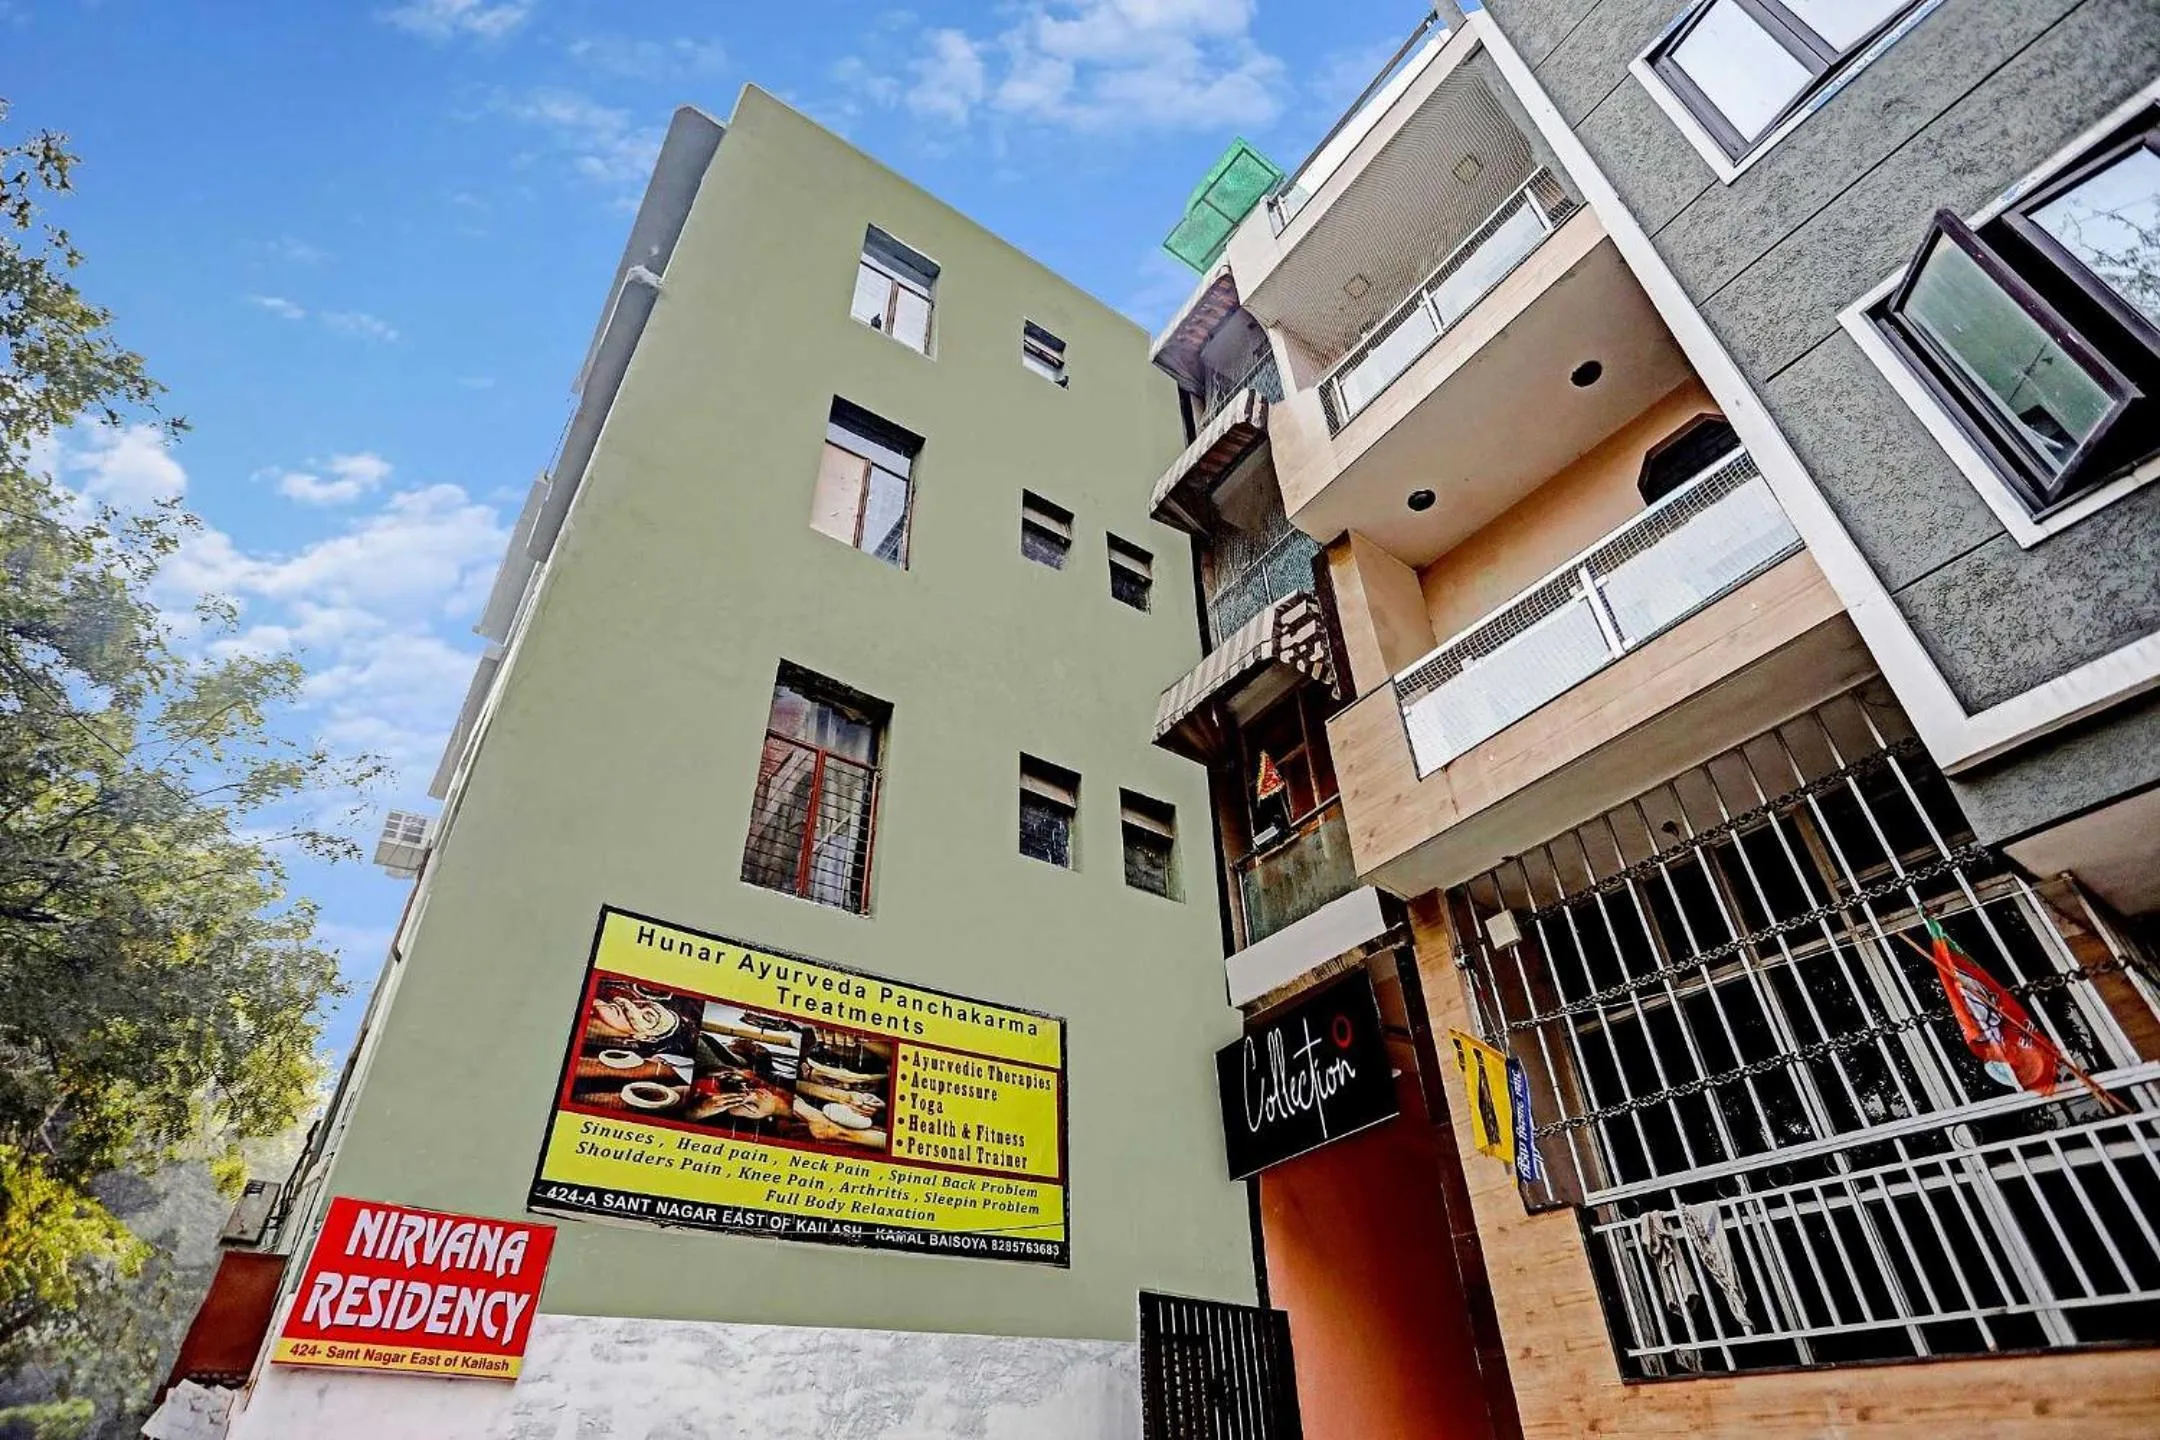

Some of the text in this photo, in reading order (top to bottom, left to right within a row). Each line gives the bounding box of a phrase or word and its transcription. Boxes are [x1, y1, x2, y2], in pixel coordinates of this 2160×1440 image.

[637, 925, 1039, 1036] Hunar Ayurveda Panchakarma
[777, 985, 924, 1035] Treatments
[911, 1071, 998, 1101] Acupressure
[912, 1051, 1051, 1090] Ayurvedic Therapies
[1244, 1016, 1356, 1139] Collection
[911, 1093, 944, 1115] Yoga
[907, 1137, 1028, 1169] Personal Trainer
[908, 1114, 1025, 1147] Health & Fitness
[575, 1141, 674, 1168] Shoulders
[738, 1166, 781, 1184] Knee
[924, 1190, 977, 1209] Sleepin
[982, 1198, 1040, 1214] Problem
[676, 1137, 725, 1156] Head
[789, 1155, 828, 1172] Neck
[888, 1169, 937, 1188] Spinal
[942, 1176, 977, 1191] Back
[981, 1181, 1038, 1198] Problem
[546, 1186, 597, 1206] 424-A
[602, 1194, 651, 1213] SANT
[656, 1201, 717, 1222] NAGAR
[722, 1210, 766, 1227] EAST
[769, 1215, 792, 1232] OF
[930, 1236, 988, 1251] BAISOYA
[765, 1189, 936, 1222] Full Body Relaxation
[345, 1208, 530, 1279] NIRVANA
[302, 1271, 531, 1347] RESIDENCY
[289, 1343, 510, 1372] 424- Sant Nagar East of Kailash
